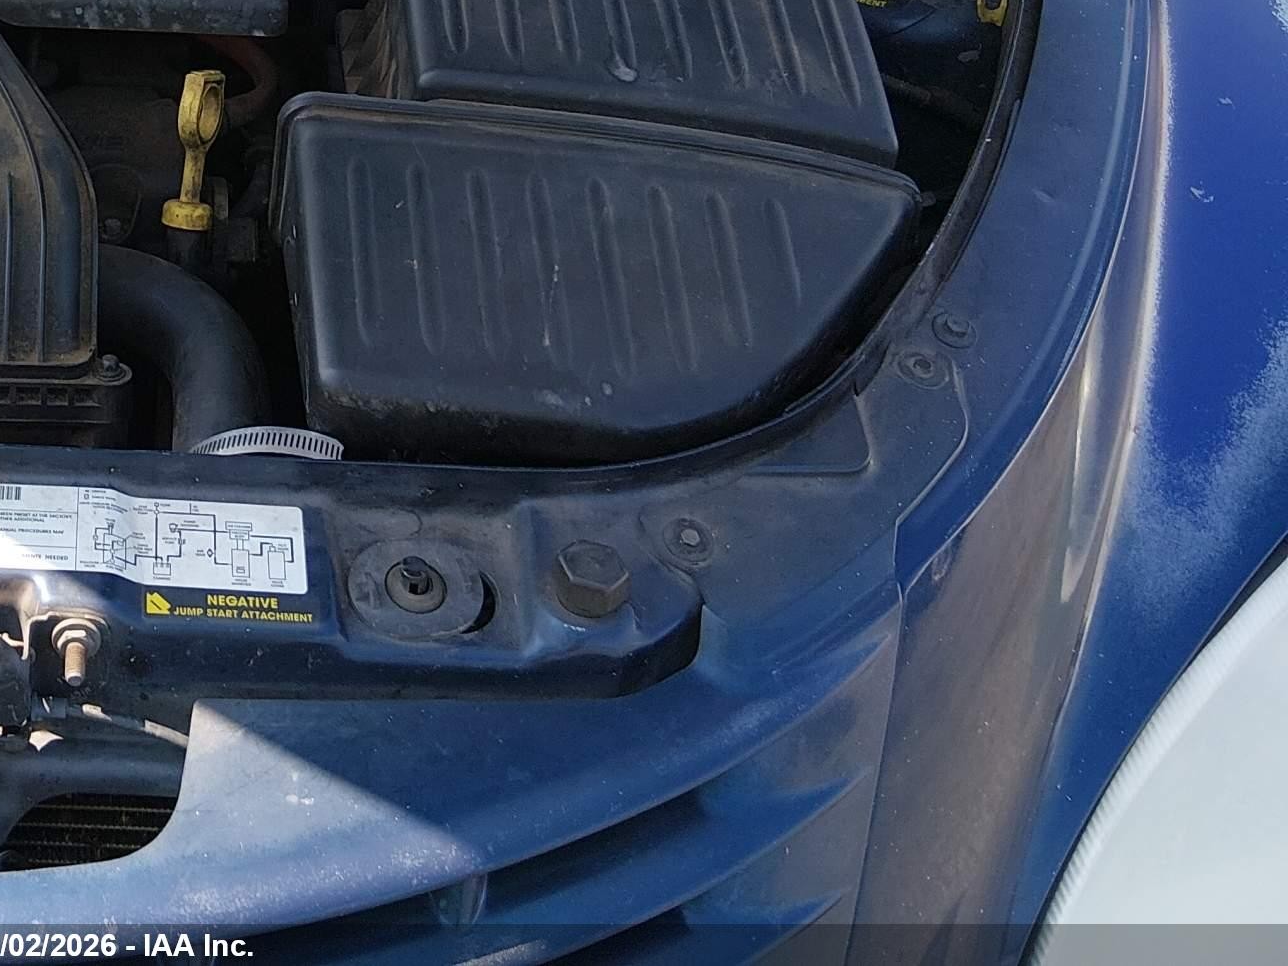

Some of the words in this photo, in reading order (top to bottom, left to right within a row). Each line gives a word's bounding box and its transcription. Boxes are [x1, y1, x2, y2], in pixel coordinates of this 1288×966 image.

[206, 594, 279, 610] NEGATIVE
[173, 607, 204, 617] JUMP
[206, 609, 238, 619] START
[240, 610, 312, 623] ATTACHMENT
